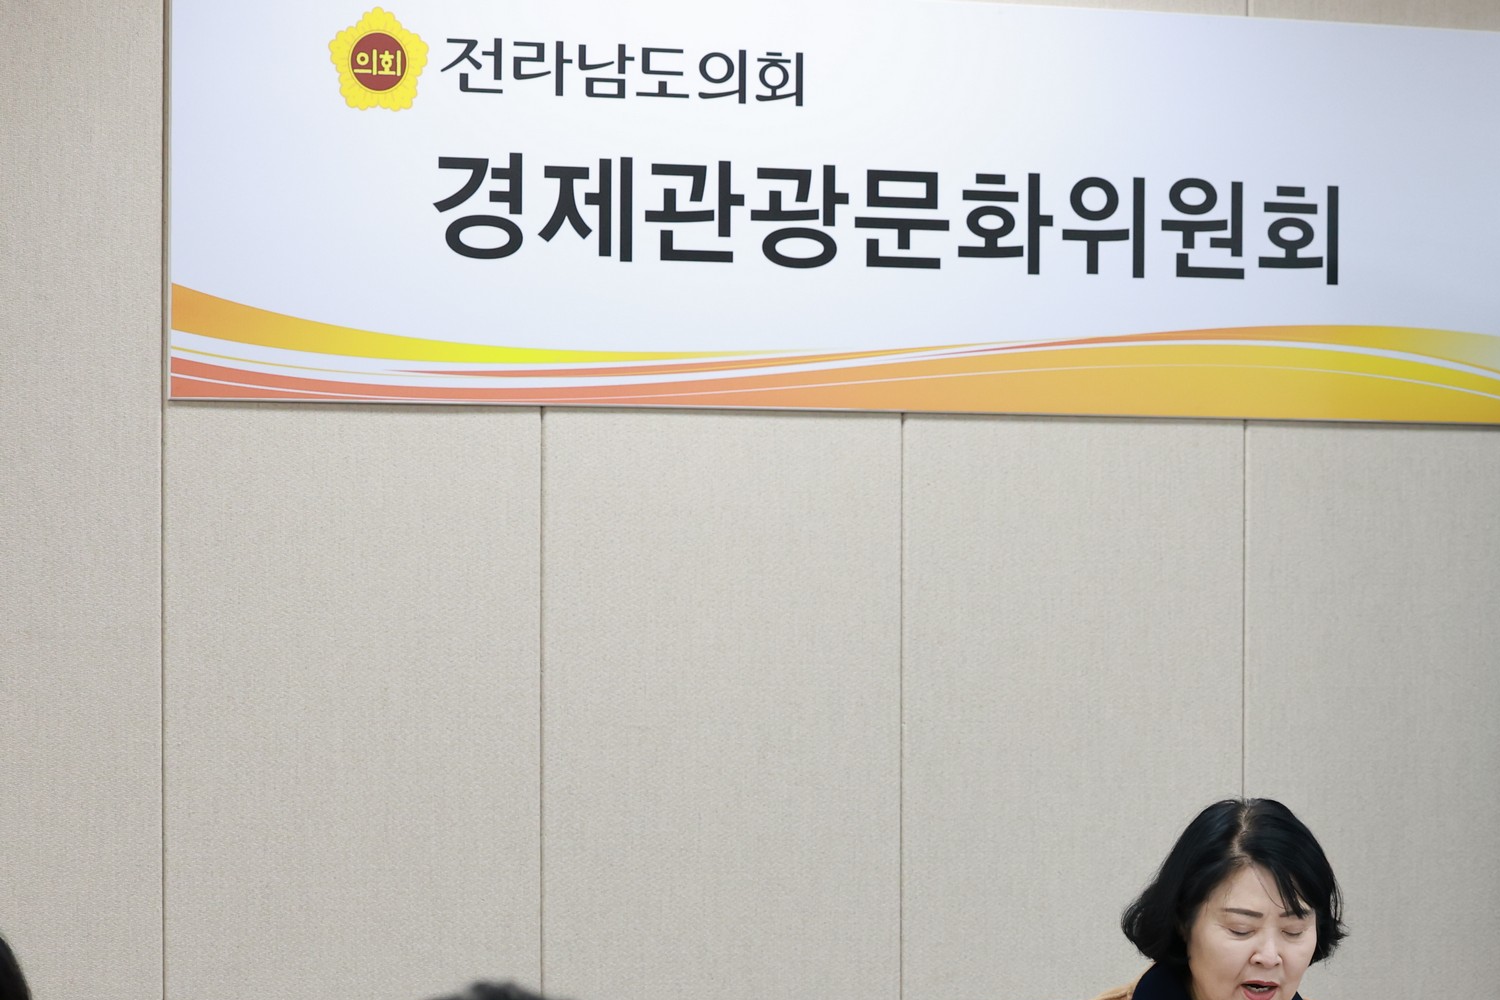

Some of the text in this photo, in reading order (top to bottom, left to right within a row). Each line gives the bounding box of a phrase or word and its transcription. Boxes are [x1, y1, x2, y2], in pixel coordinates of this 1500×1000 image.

[353, 48, 403, 78] 의회
[440, 37, 804, 107] 전라남도의회
[433, 152, 1339, 286] 경제관광문화위원회
